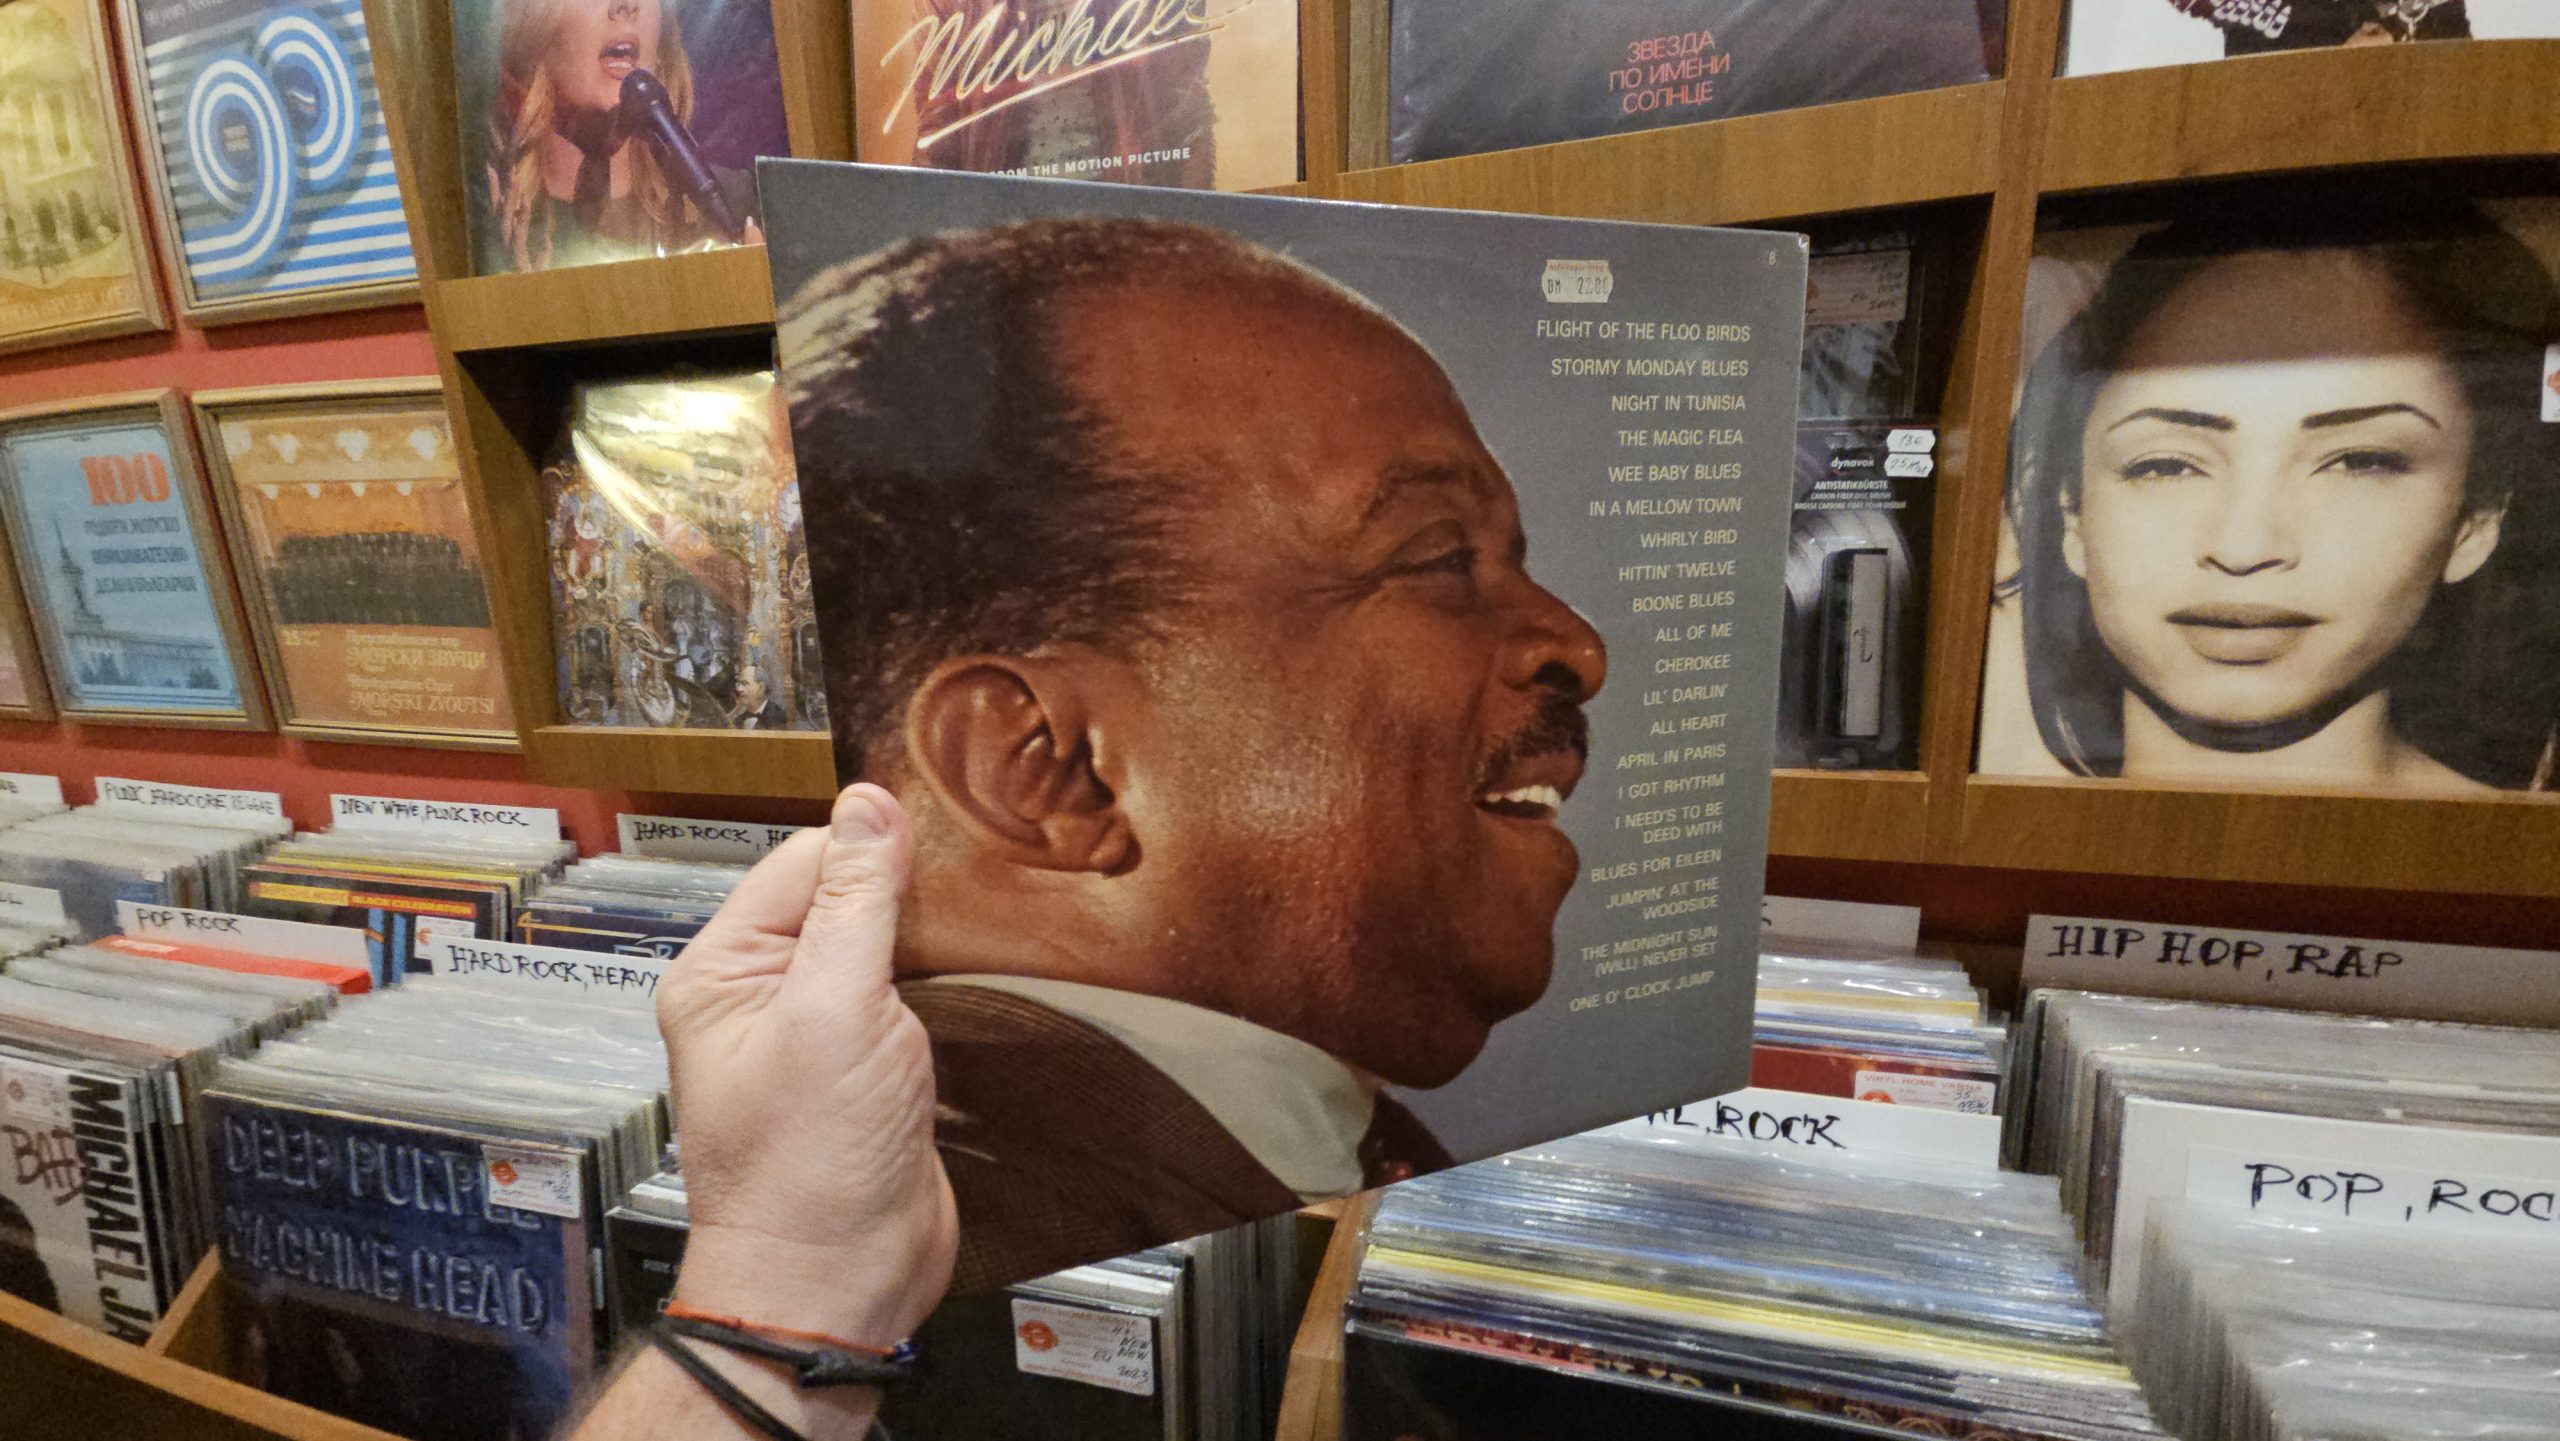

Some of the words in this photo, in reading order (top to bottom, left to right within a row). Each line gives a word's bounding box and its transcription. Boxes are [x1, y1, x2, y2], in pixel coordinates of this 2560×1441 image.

[1627, 30, 1715, 63] ЗВЕЗДА
[1609, 68, 1642, 91] ПО
[1649, 53, 1730, 84] ИМЕНИ
[1623, 80, 1713, 113] СОЛНЦЕ
[1032, 163, 1059, 176] THE
[1065, 156, 1122, 173] MOTION
[1128, 147, 1191, 165] PICTURE
[1536, 319, 1594, 338] FLIGHT
[1598, 321, 1620, 339] OF
[1625, 321, 1656, 340] THE
[1660, 322, 1701, 341] FLOO
[1705, 324, 1751, 343] BIRDS
[1551, 358, 1621, 376] STORMY
[1626, 359, 1697, 377] MONDAY
[1701, 359, 1749, 377] BLUES
[1611, 394, 1659, 412] NIGHT
[1664, 394, 1681, 411] IN
[1686, 394, 1746, 412] TUNISIA
[1617, 429, 1648, 447] THE
[1653, 429, 1703, 446] MAGIC
[1708, 428, 1744, 446] FLEA
[1608, 465, 1643, 483] WEE
[1648, 464, 1690, 482] BABY
[1694, 463, 1742, 480] BLUES
[1831, 456, 1875, 470] dynavox
[82, 452, 170, 506] 100
[1589, 500, 1606, 517] IN
[1609, 500, 1622, 516] A
[1625, 498, 1693, 516] MELLOW
[1695, 496, 1742, 514] TOWN
[1640, 531, 1699, 549] WHIRLY
[1703, 528, 1738, 545] BIRD
[1618, 564, 1671, 582] HITTIN'
[1676, 559, 1736, 578] TWELVE
[1632, 594, 1684, 613] BOONE
[1688, 590, 1735, 609] BLUES
[1654, 627, 1682, 643] ALL
[1686, 624, 1707, 641] OF
[1710, 622, 1733, 638] ME
[1654, 653, 1731, 674] CHEROKEE
[1643, 689, 1668, 707] LIL'
[1672, 683, 1729, 703] DARLIN'
[1649, 720, 1677, 736] ALL
[1680, 713, 1728, 731] HEART
[1616, 752, 1659, 770] APRIL
[1663, 749, 1679, 764] IN
[1683, 743, 1727, 761] PARIS
[1617, 786, 1624, 800] I
[1627, 781, 1660, 799] GOT
[1663, 772, 1725, 794] RHYTHM
[470, 808, 530, 827] ROCK
[1614, 816, 1621, 830] I
[1624, 808, 1678, 829] NEED'S
[1681, 804, 1701, 820] TO
[1705, 801, 1724, 817] BE
[634, 821, 685, 842] HARD
[1685, 820, 1723, 838] WITH
[1590, 861, 1638, 883] BLUES
[1642, 857, 1672, 873] FOR
[1675, 848, 1722, 868] EILEEN
[1669, 881, 1689, 896] AT
[1694, 876, 1720, 892] THE
[1641, 894, 1719, 921] WOODSIDE
[136, 908, 174, 932] POP
[181, 912, 244, 936] ROCK
[1581, 943, 1608, 961] THE
[1613, 930, 1686, 957] MIDNIGHT
[1687, 925, 1719, 944] SUN
[1642, 947, 1688, 967] NEVER
[1691, 941, 1717, 958] SET
[2047, 924, 2146, 959] HIP
[2285, 944, 2404, 979] RAP
[446, 945, 512, 974] HARD
[1569, 993, 1600, 1012] ONE
[1604, 989, 1620, 1005] O'
[1624, 979, 1671, 1001] CLOCK
[1675, 970, 1715, 991] JUMP
[225, 1115, 328, 1189] DEEP
[67, 1074, 148, 1282] MICHAEL
[2428, 1179, 2560, 1222] ROC
[226, 1204, 400, 1302] MACHINE
[411, 1247, 548, 1333] HEAD
